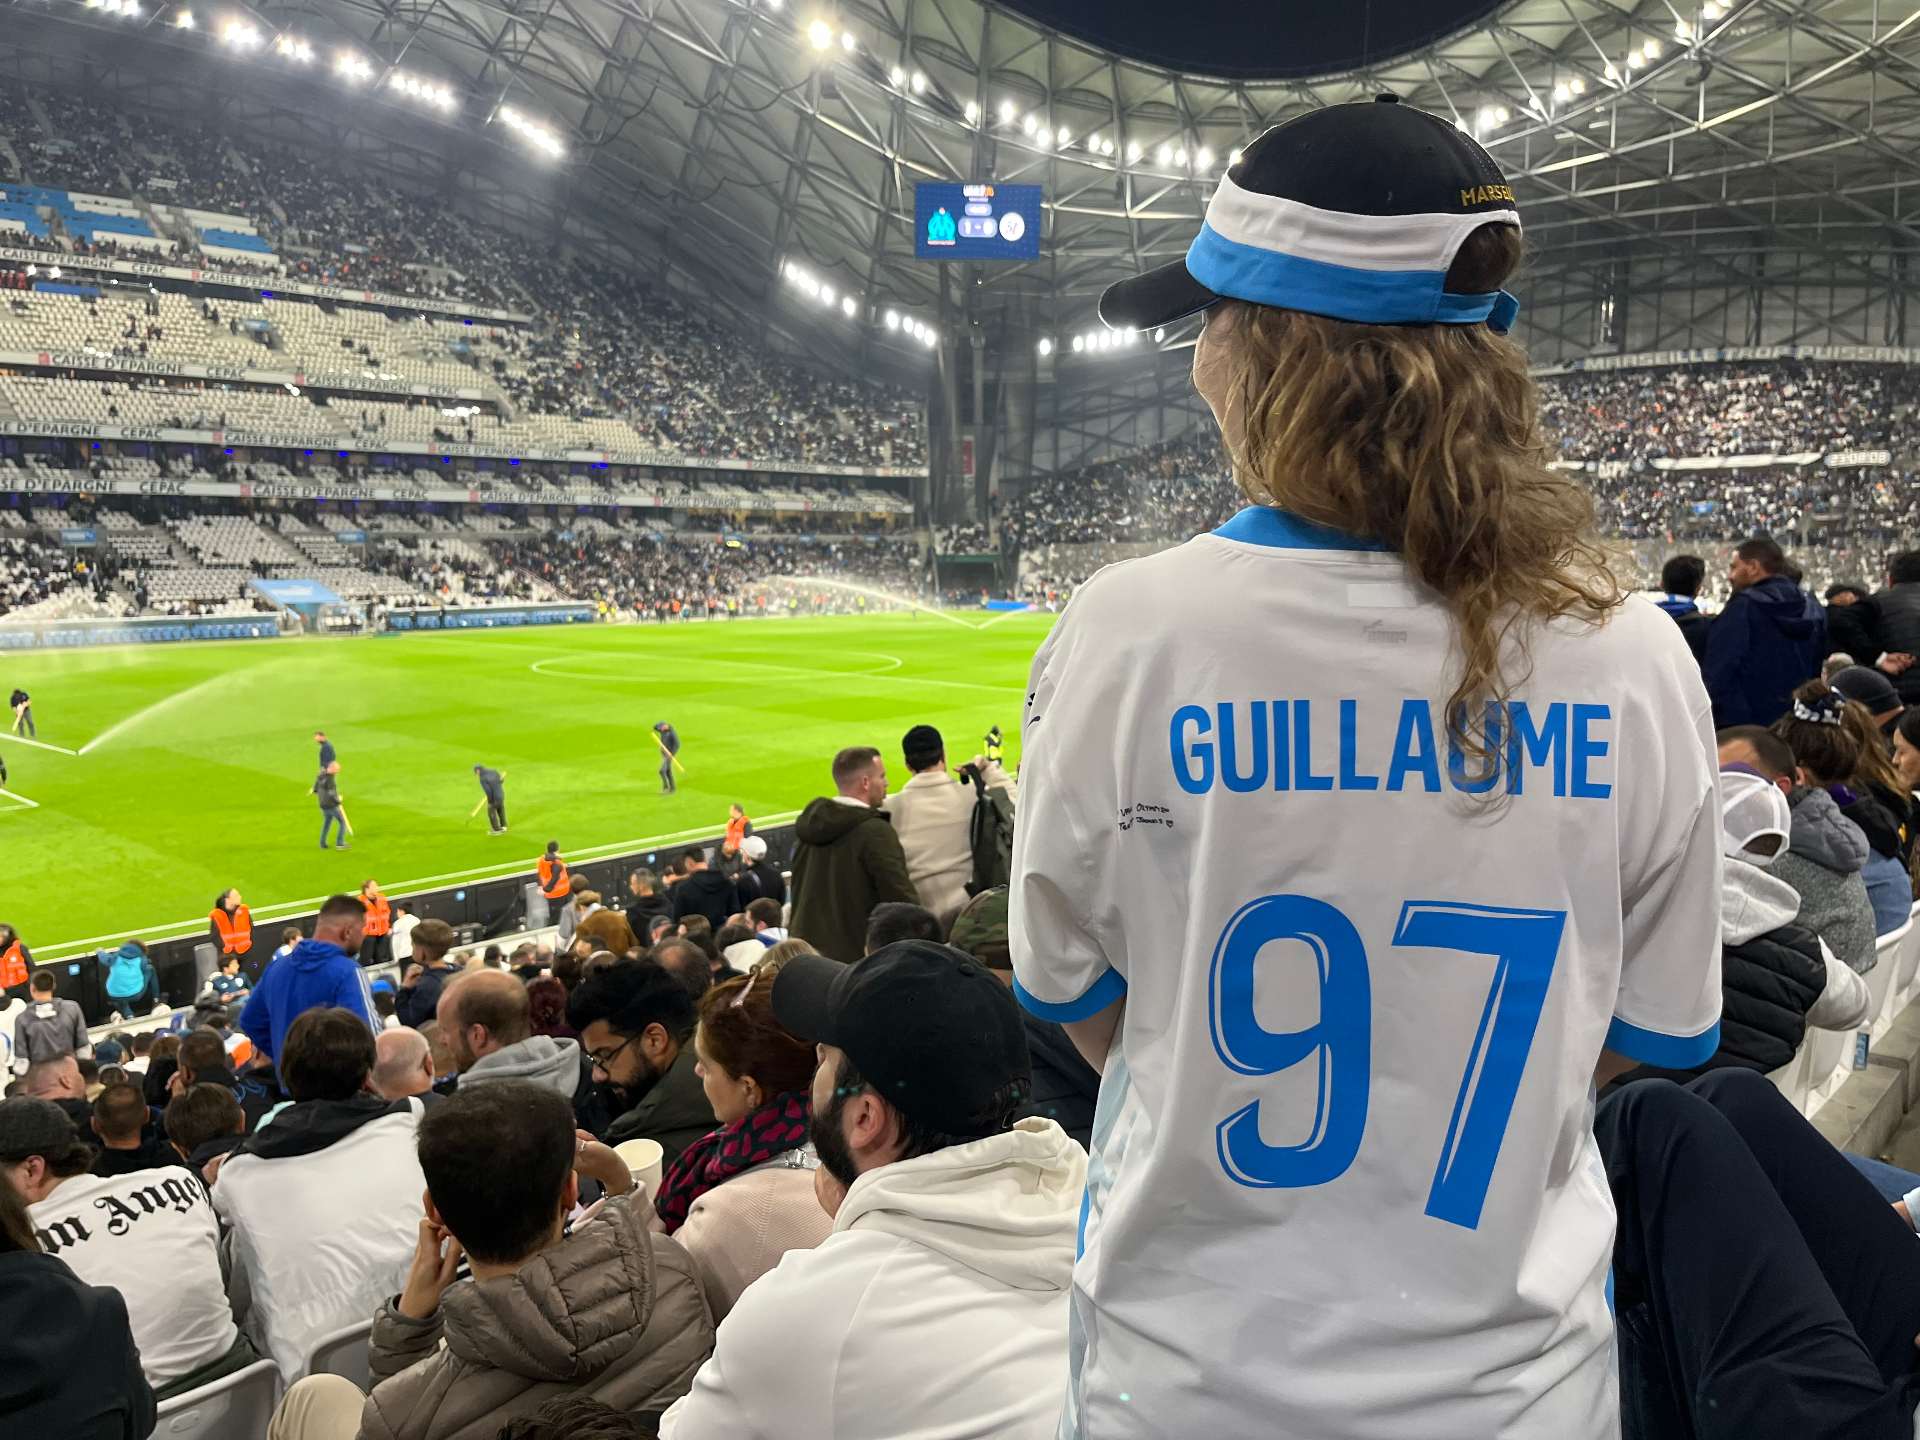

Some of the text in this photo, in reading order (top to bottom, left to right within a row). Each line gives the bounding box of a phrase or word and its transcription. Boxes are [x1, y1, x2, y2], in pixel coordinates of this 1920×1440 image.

[2, 248, 43, 260] CAISSE
[131, 262, 166, 276] CEPAC
[52, 354, 246, 380] CAISSE D'EPARGNE CEPAC
[1585, 348, 1718, 371] MARSEILLE
[1724, 346, 1789, 361] TROP
[306, 376, 345, 388] CAISSE
[428, 386, 460, 398] CEPAC
[120, 427, 163, 440] CEPAC
[225, 433, 266, 445] CAISSE
[355, 439, 389, 451] CEPAC
[24, 478, 117, 493] D'EPARGNE
[139, 481, 186, 494] CEPAC
[253, 484, 298, 497] CAISSE
[392, 489, 429, 500] CEPAC
[1169, 700, 1611, 799] GUILLAUME
[1208, 893, 1568, 1231] 97
